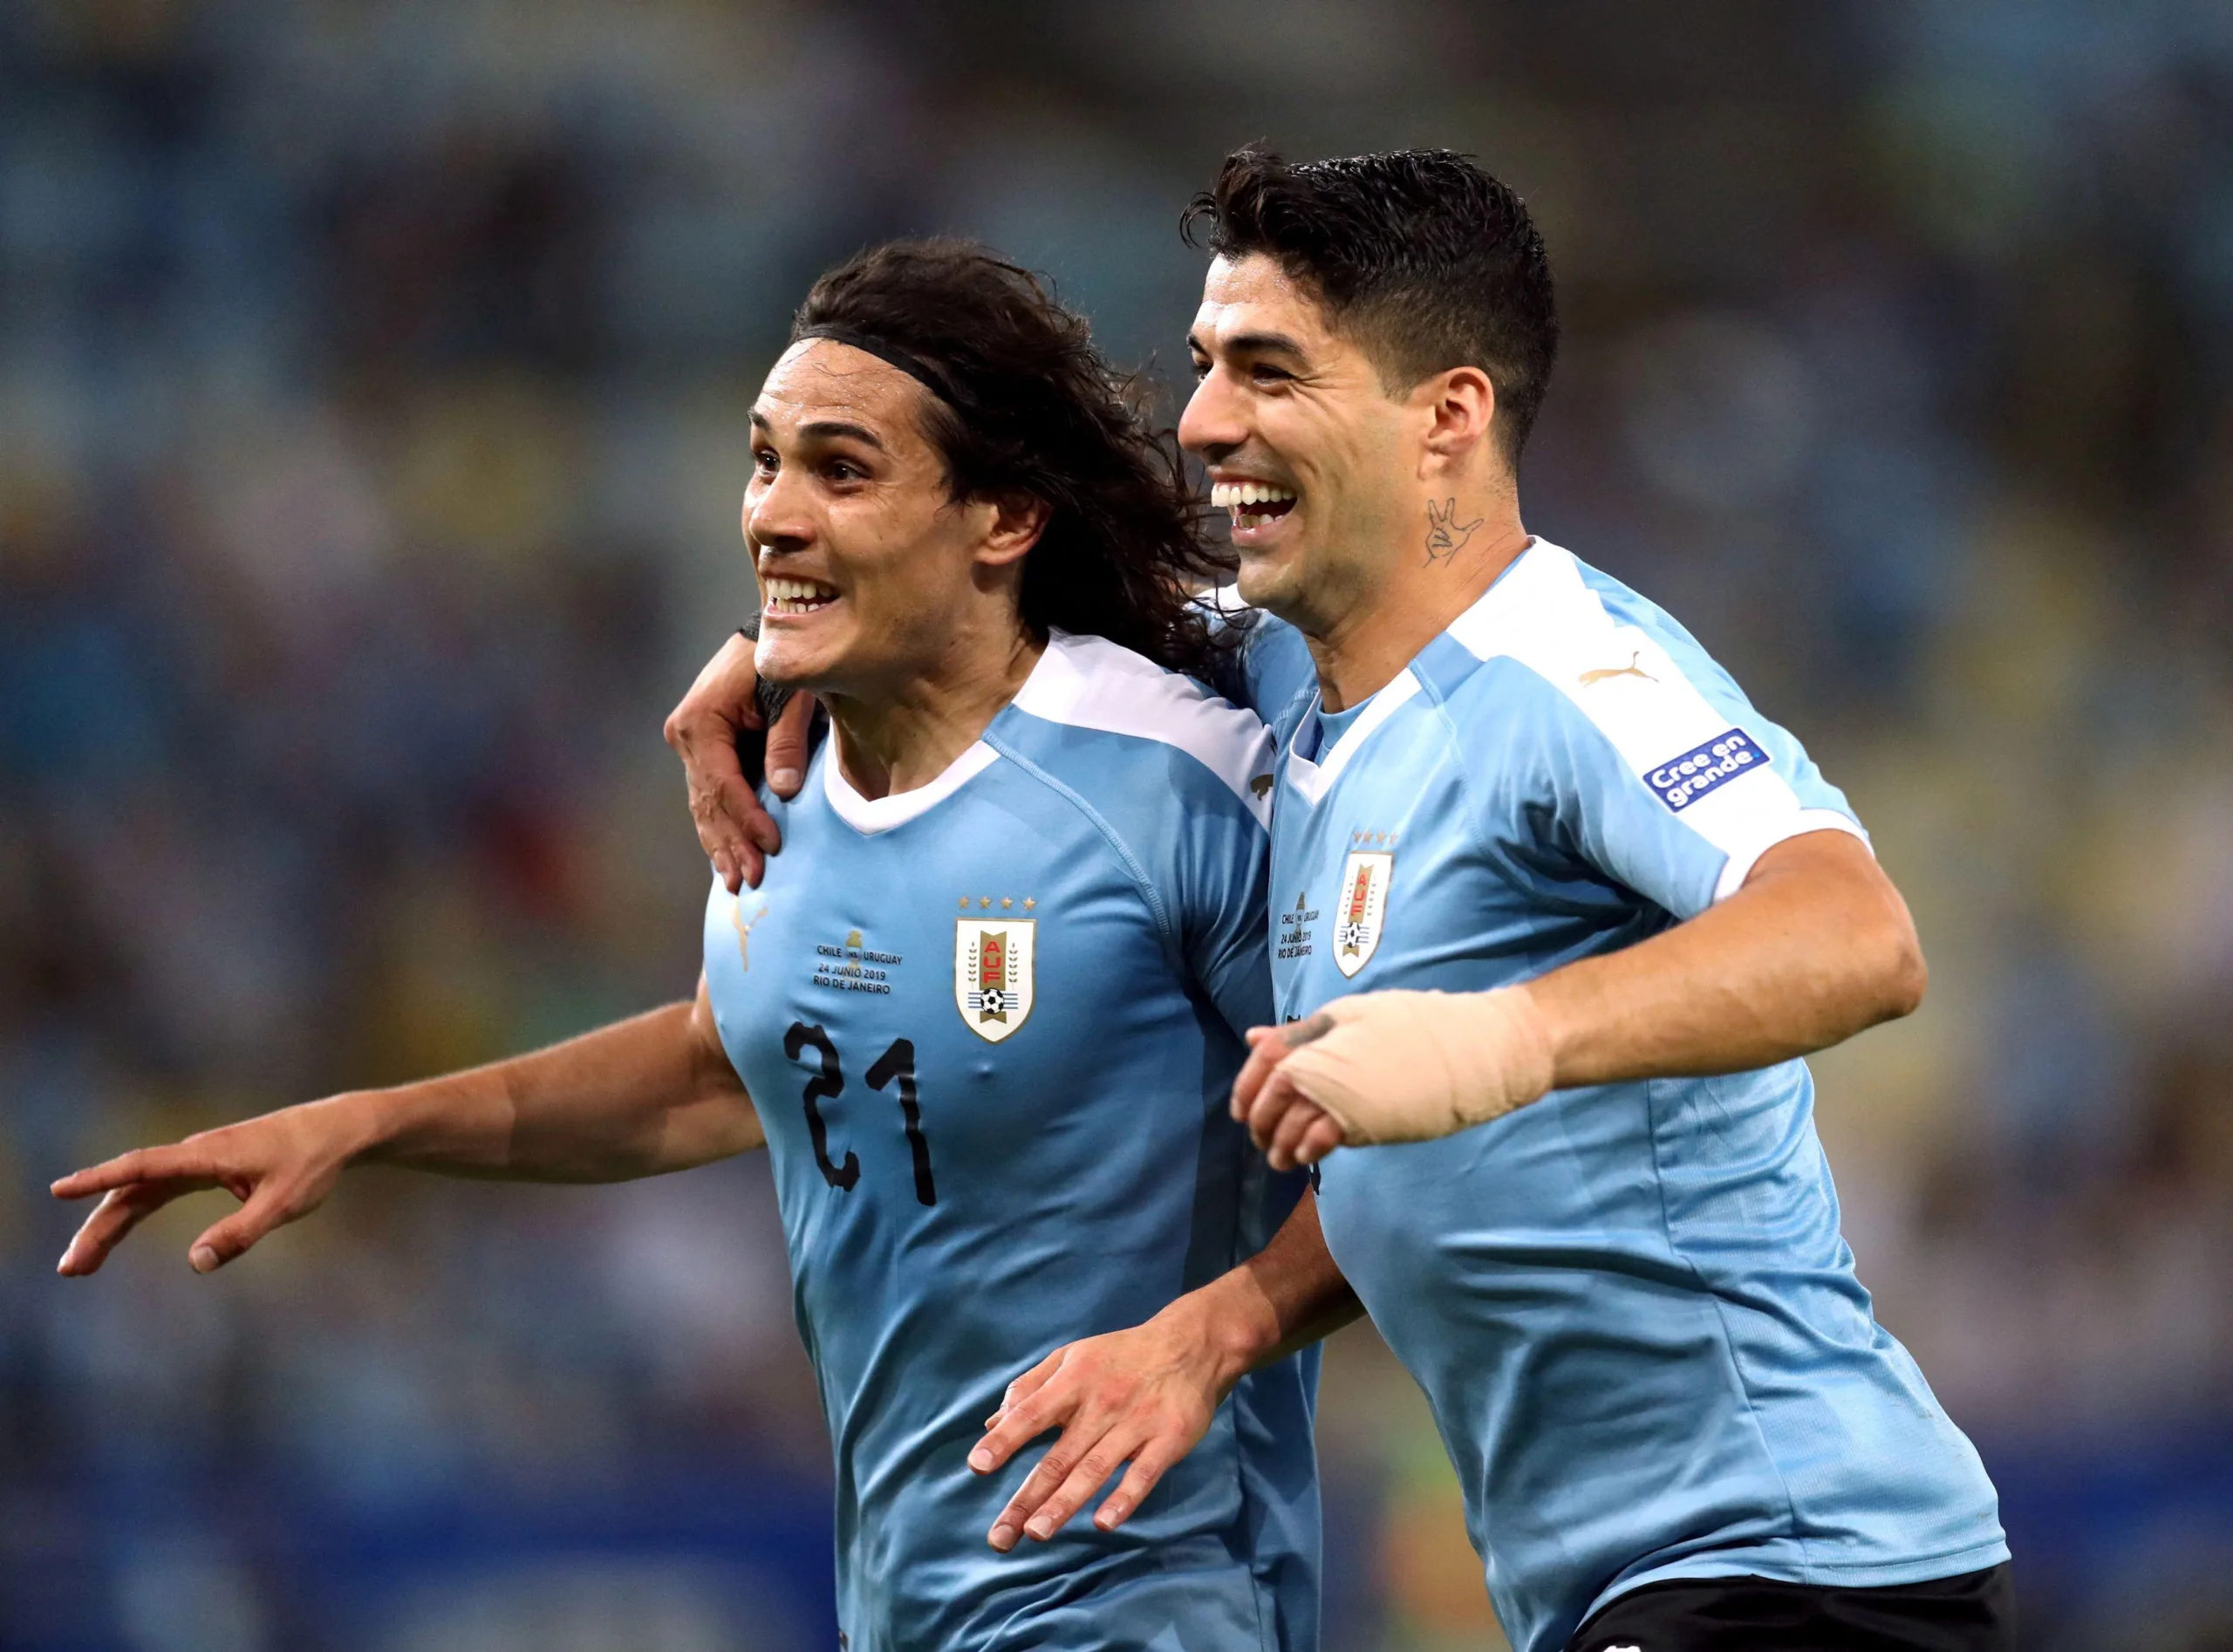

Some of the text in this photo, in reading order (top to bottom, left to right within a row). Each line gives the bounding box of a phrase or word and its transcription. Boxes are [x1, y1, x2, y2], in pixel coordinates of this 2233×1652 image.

[1651, 735, 1746, 788] Cree en
[1666, 750, 1754, 808] grande
[1350, 874, 1367, 917] AUF
[1278, 948, 1287, 959] RIO
[1287, 947, 1294, 959] DE
[1280, 933, 1287, 944] 24
[817, 945, 842, 958] CHILE
[864, 951, 903, 966] URUGUAY
[983, 941, 1001, 984] AUF
[813, 975, 891, 995] RIO DE JANEIRO
[819, 963, 886, 981] 24 JUNIO 2019
[783, 1021, 937, 1207] 21
